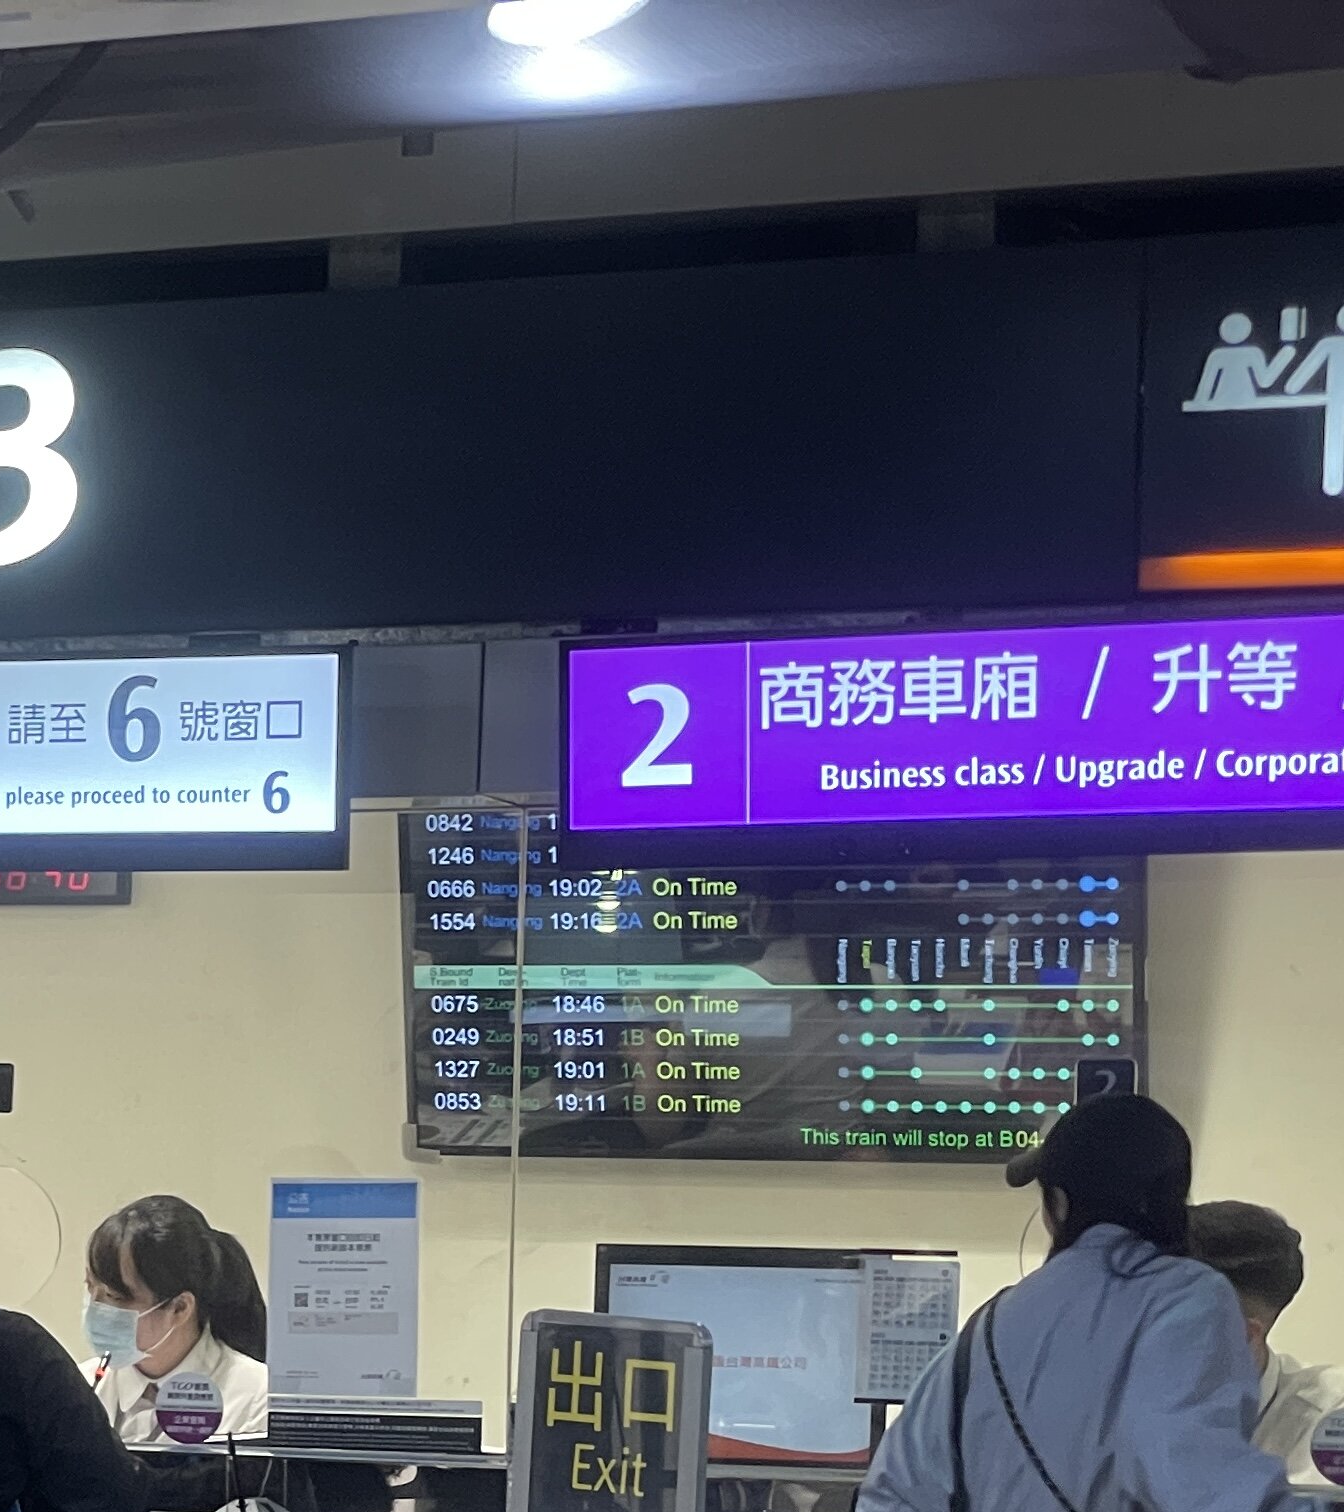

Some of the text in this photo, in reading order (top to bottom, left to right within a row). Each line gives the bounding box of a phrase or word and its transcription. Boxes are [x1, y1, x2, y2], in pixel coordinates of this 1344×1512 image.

[759, 640, 1298, 730] 商務車廂 / 升等
[8, 703, 87, 745] 請至
[107, 674, 161, 763] 6
[179, 699, 303, 742] 號窗口
[621, 683, 693, 787] 2
[819, 760, 946, 793] Business
[954, 752, 1025, 787] class
[1056, 753, 1185, 794] Upgrade
[6, 786, 65, 809] please
[71, 784, 145, 809] proceed
[151, 787, 171, 804] to
[177, 787, 251, 804] counter
[262, 770, 291, 814] 6
[425, 813, 474, 832] 0842
[428, 846, 475, 865] 1246
[427, 877, 738, 899] 0666 19:02 On Time
[429, 911, 738, 931] 1554 On Time
[431, 995, 739, 1015] 0675 18:46 On Time
[432, 1027, 740, 1047] 0249 18:51 On Time
[434, 1060, 741, 1080] 1327 19:01 On Time
[434, 1092, 741, 1113] 0853 19:11 On Time
[799, 1127, 994, 1150] This train will stop at
[544, 1340, 677, 1434] 出口
[569, 1442, 647, 1499] Exit
